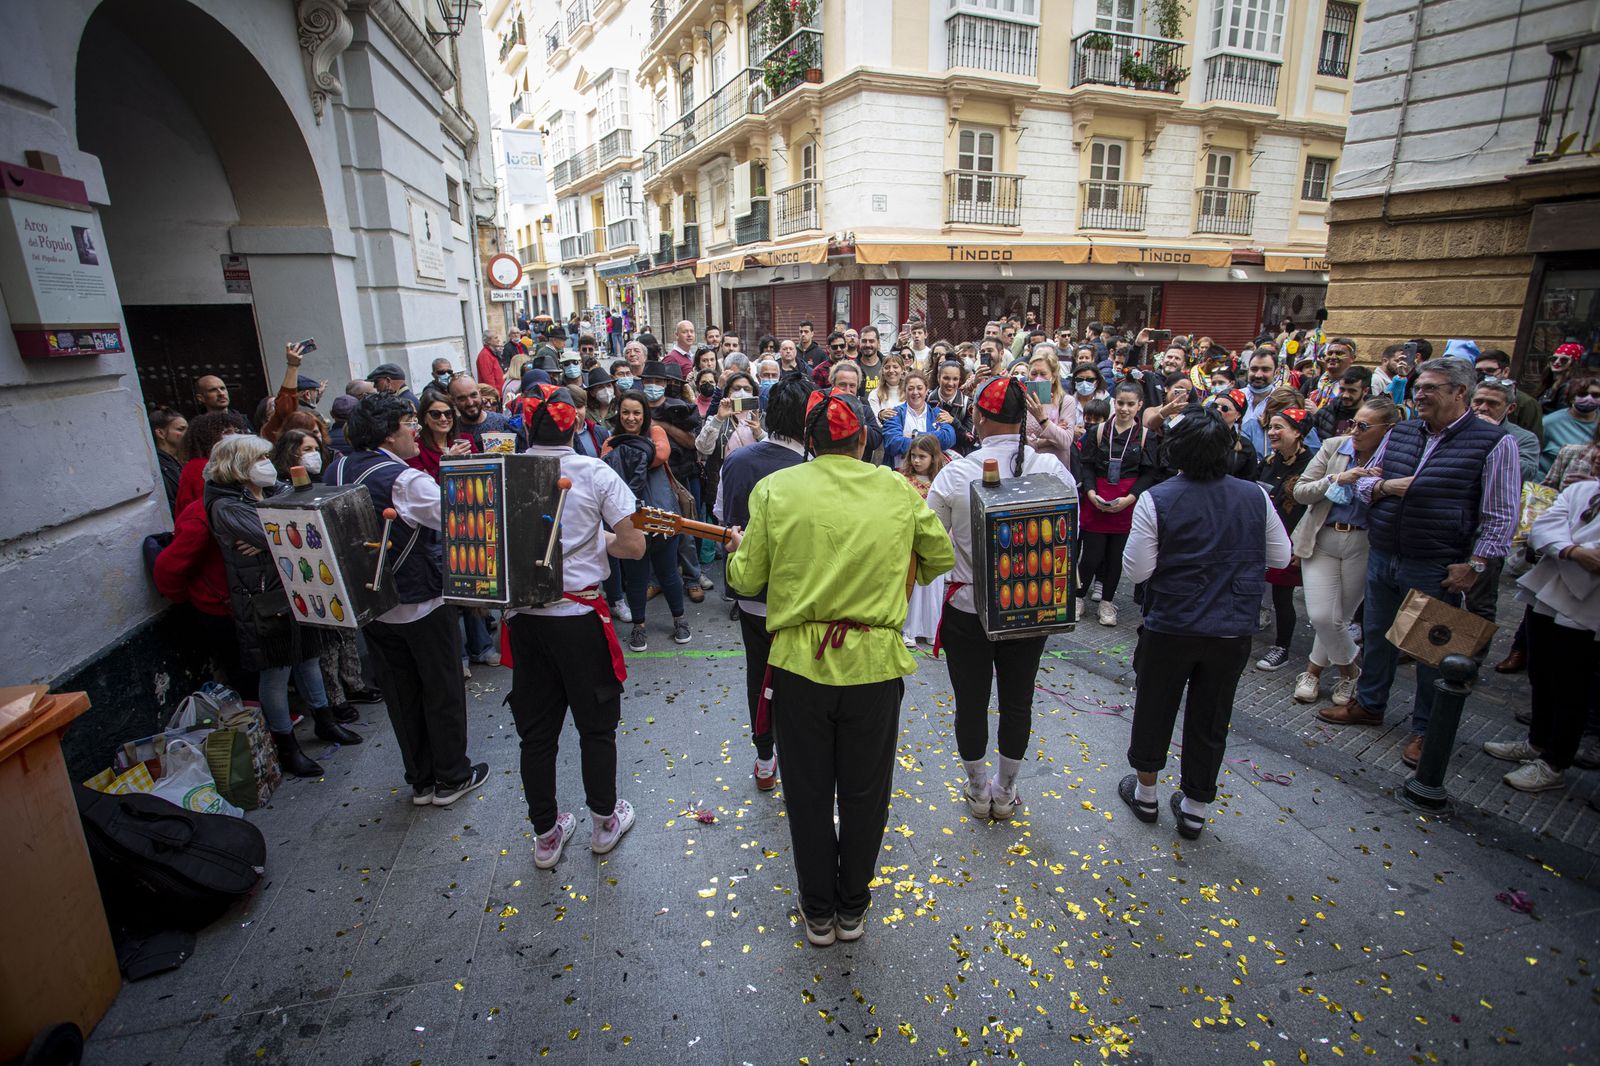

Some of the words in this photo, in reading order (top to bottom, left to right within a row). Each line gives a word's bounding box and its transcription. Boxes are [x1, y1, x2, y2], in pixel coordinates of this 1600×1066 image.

[24, 217, 48, 232] Arco
[28, 238, 38, 247] del
[38, 235, 73, 252] Pópulo
